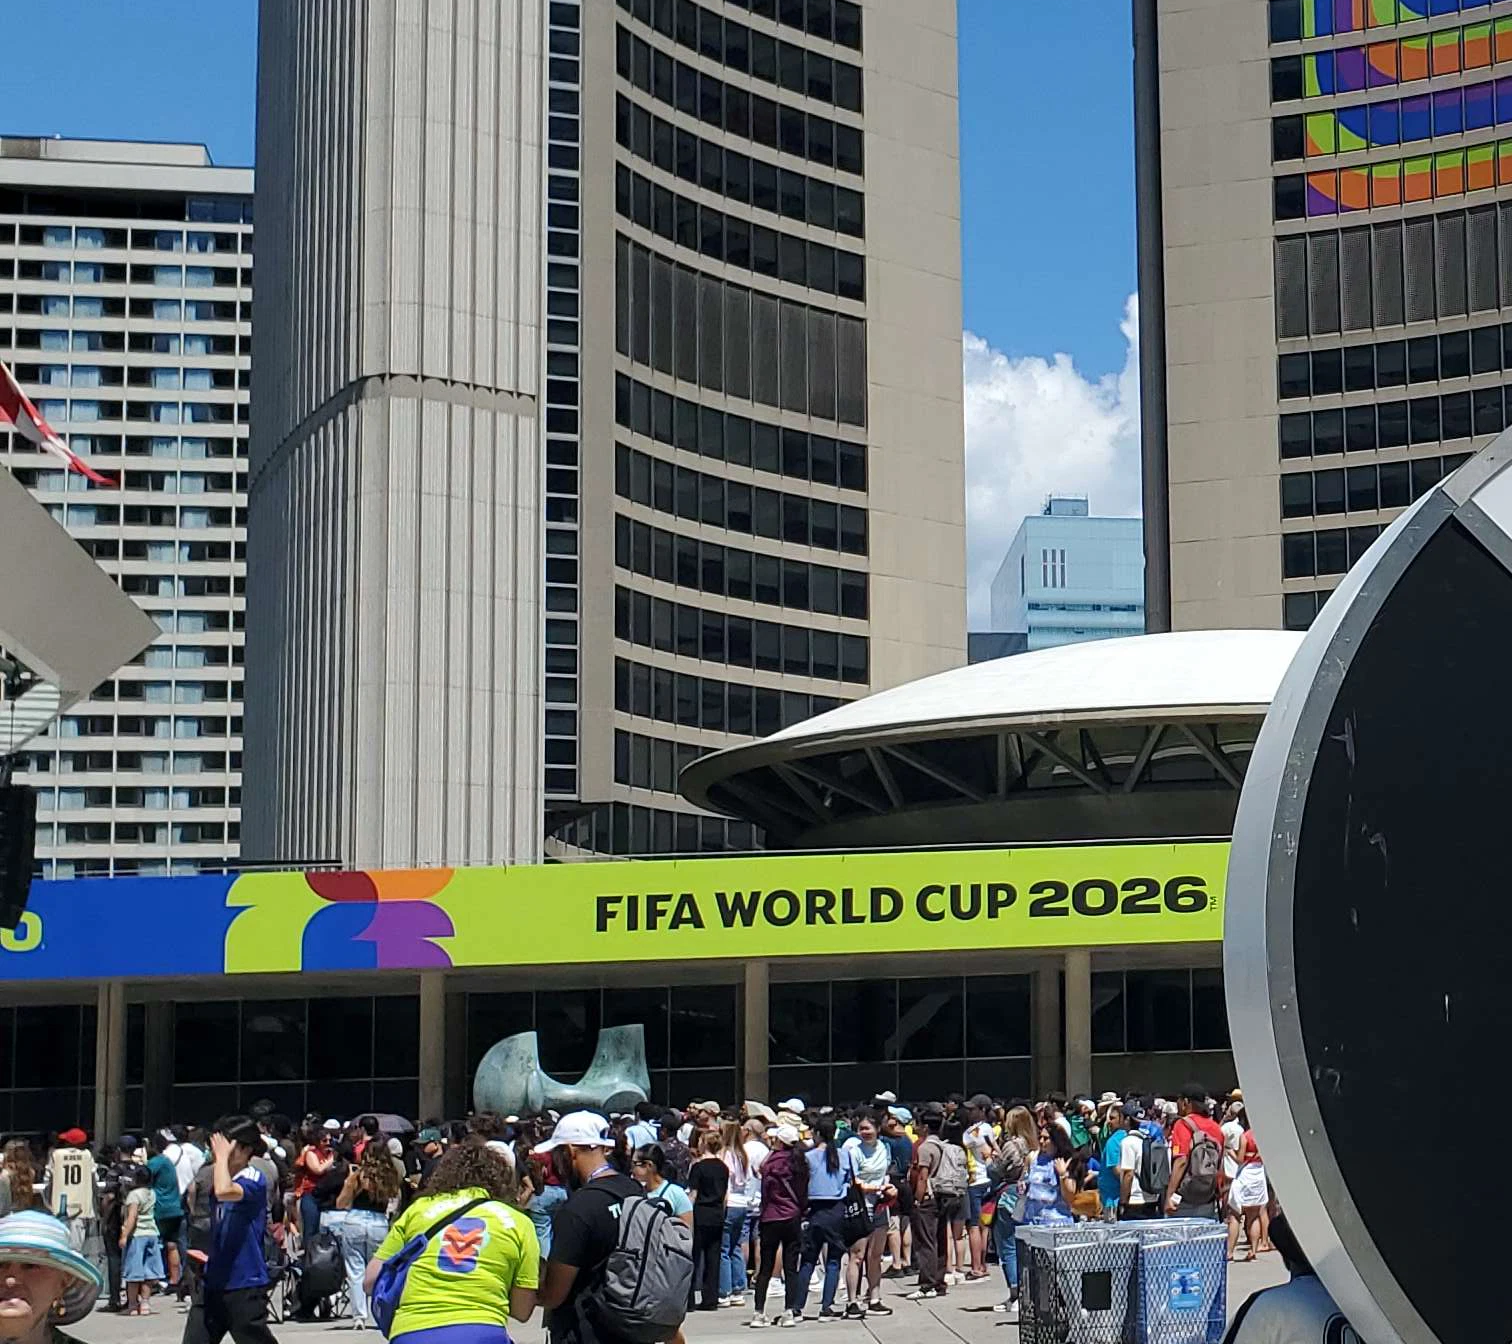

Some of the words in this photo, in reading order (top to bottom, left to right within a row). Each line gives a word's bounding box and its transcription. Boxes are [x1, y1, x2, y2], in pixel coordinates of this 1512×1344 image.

[596, 893, 706, 933] FIFA
[714, 887, 904, 928] WORLD
[915, 882, 1018, 922] CUP
[1028, 875, 1208, 919] 2026
[62, 1163, 82, 1185] 10
